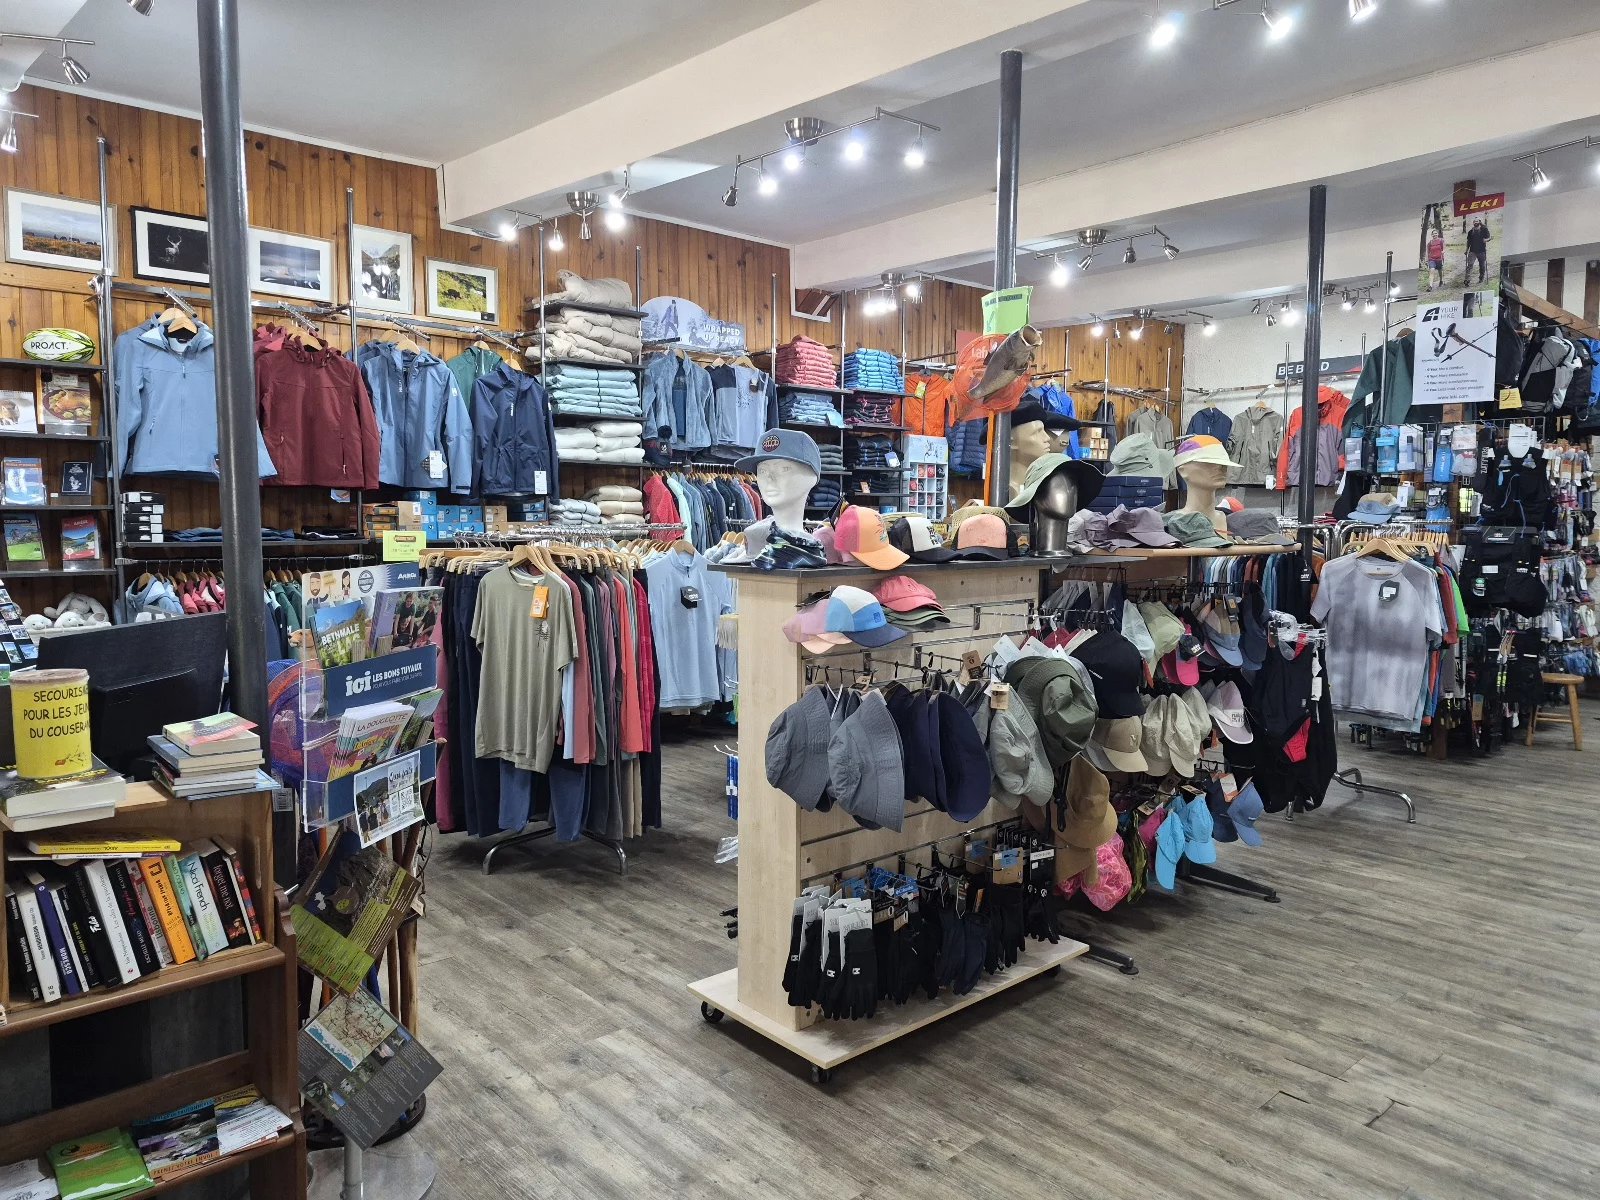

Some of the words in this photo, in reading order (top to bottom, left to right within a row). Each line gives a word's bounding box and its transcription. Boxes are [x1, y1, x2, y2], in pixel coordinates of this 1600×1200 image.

[1460, 198, 1499, 211] LEKI
[1441, 306, 1458, 314] YOUR
[703, 324, 740, 336] WRAPPED
[703, 334, 714, 342] UP
[716, 334, 740, 344] READY
[1278, 365, 1294, 376] BE
[1296, 361, 1330, 374] BD
[321, 623, 361, 647] BETHMALE
[372, 672, 383, 683] LES
[383, 667, 401, 680] BONS
[400, 662, 422, 676] TUYAUX
[345, 670, 372, 697] ici
[23, 709, 49, 720] POUR
[52, 706, 72, 720] LES
[29, 727, 44, 739] DU
[357, 724, 366, 732] LA
[187, 861, 199, 885] Nicci
[195, 883, 210, 912] French
[213, 864, 226, 886] forget
[225, 896, 235, 910] not
[59, 947, 73, 975] MORESCO
[195, 1153, 214, 1162] ENVOL
